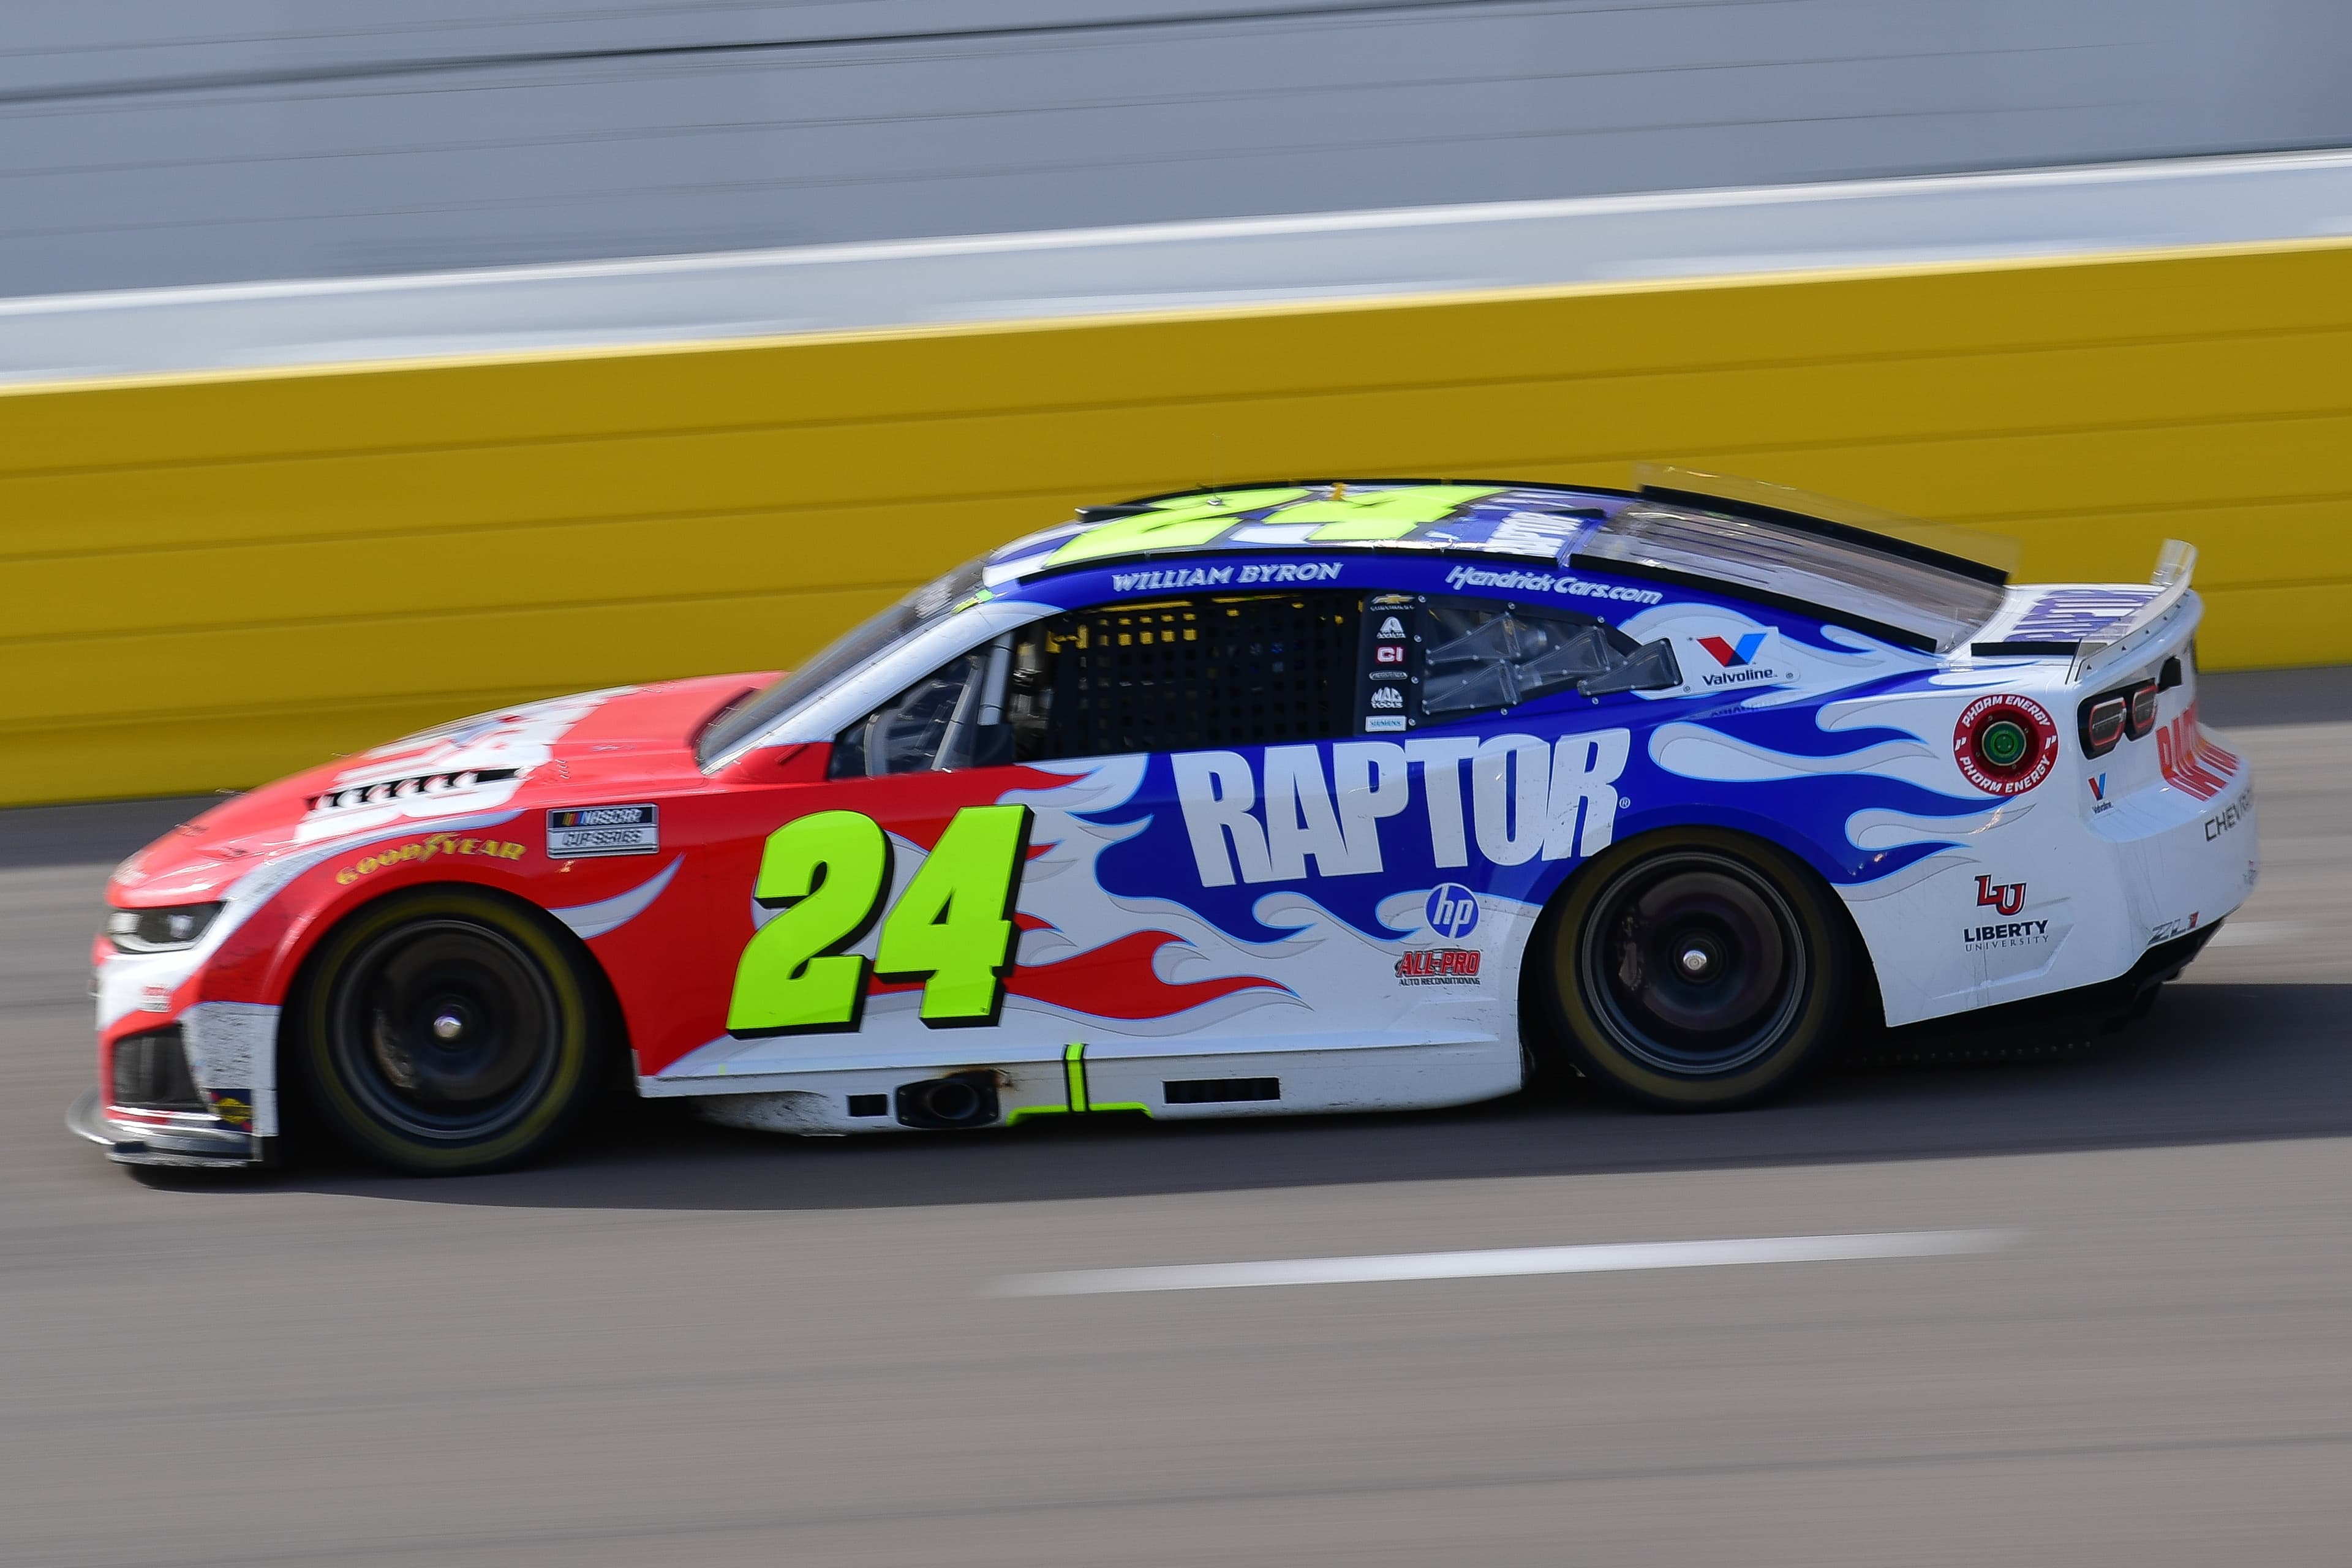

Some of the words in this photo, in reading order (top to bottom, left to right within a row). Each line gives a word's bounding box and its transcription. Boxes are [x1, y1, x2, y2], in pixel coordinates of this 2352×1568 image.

[1111, 565, 1234, 592] WILLIAM
[1237, 562, 1344, 584] BYRON
[1702, 668, 1774, 686] Valvoline
[1371, 687, 1403, 703] MAC
[1961, 695, 2003, 728] PHORM
[2005, 695, 2051, 726] ENERGY
[1959, 755, 2003, 793] PHORM
[2005, 754, 2051, 793] ENERGY
[582, 808, 643, 826] NASCAR
[562, 831, 589, 847] CUP
[590, 829, 643, 845] SERIES
[335, 832, 527, 886] GOODYEAR
[1973, 874, 2027, 916] LU
[726, 803, 1034, 1039] 24
[1432, 883, 1474, 939] hp
[1963, 919, 2049, 943] LIBERTY
[2147, 911, 2199, 945] ZL1
[1965, 935, 2049, 952] UNIVERSITY
[1395, 950, 1482, 978] ALL-PRO
[1420, 977, 1481, 986] RECONDITIONING
